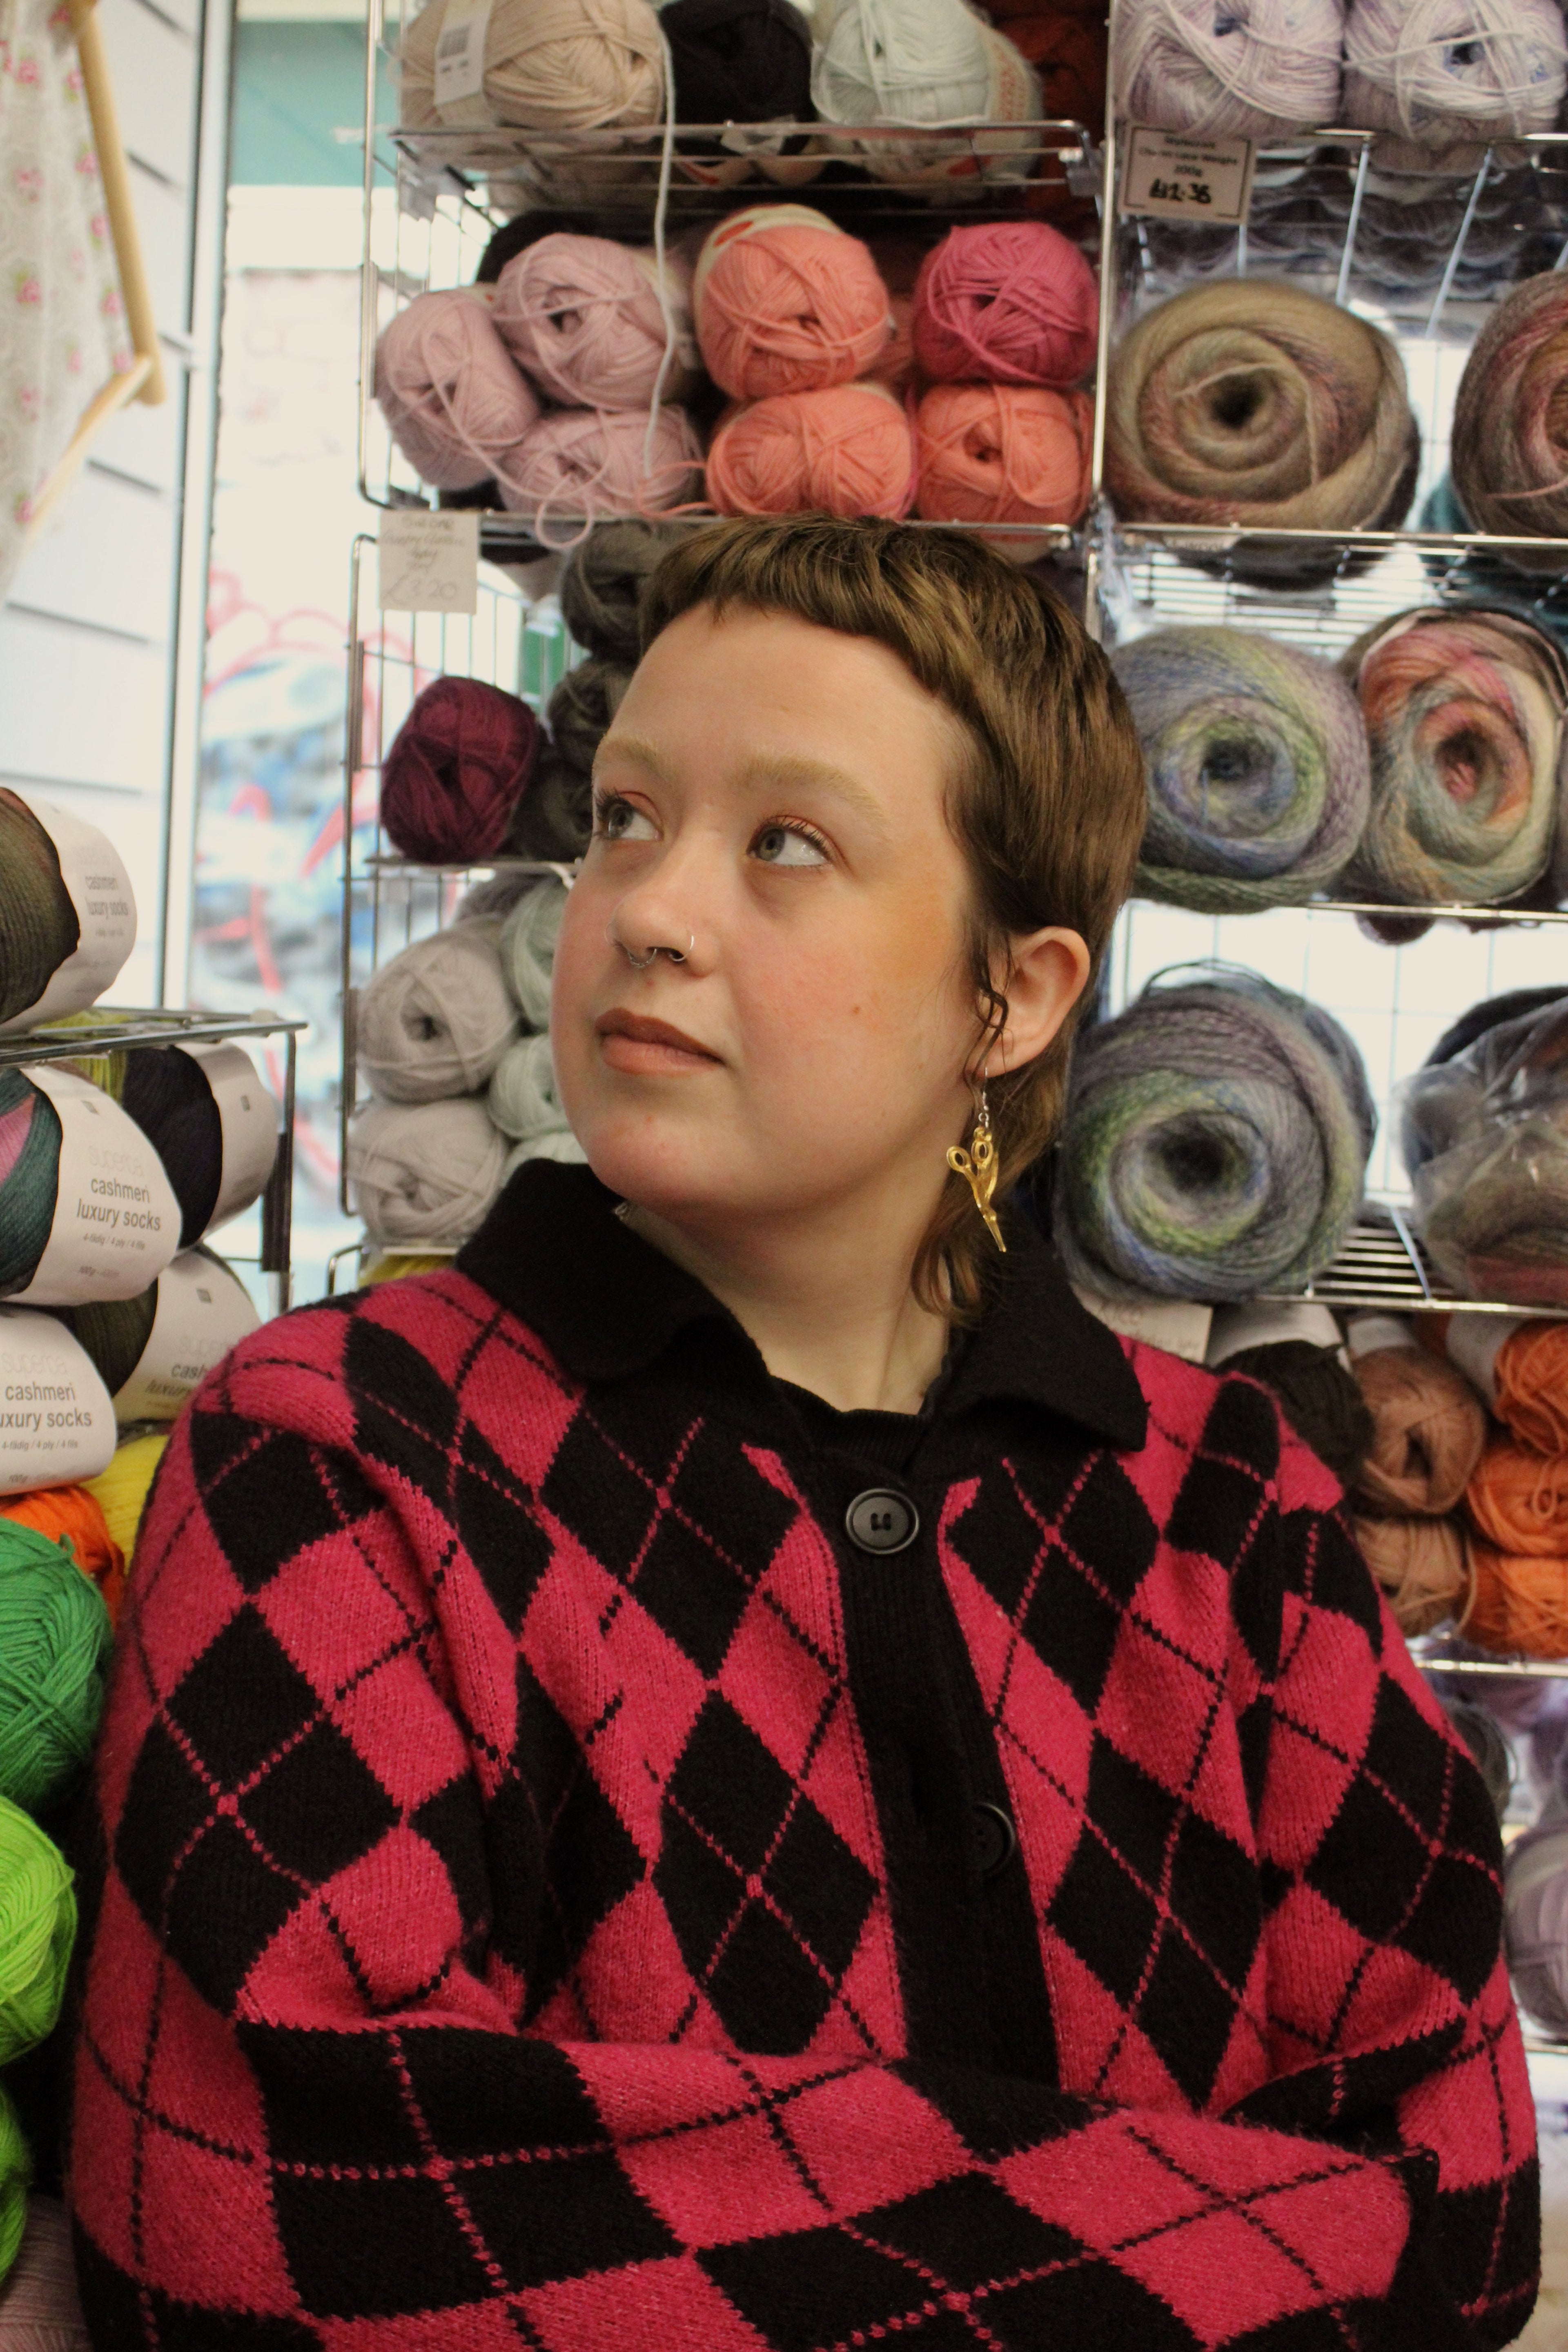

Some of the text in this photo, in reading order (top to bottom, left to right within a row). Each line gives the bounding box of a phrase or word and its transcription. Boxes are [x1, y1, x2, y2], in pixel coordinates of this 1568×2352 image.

[91, 1178, 150, 1203] cashmeri
[76, 1198, 162, 1232] luxury socks
[5, 1381, 76, 1401] cashmeri
[0, 1407, 92, 1432] uxury socks
